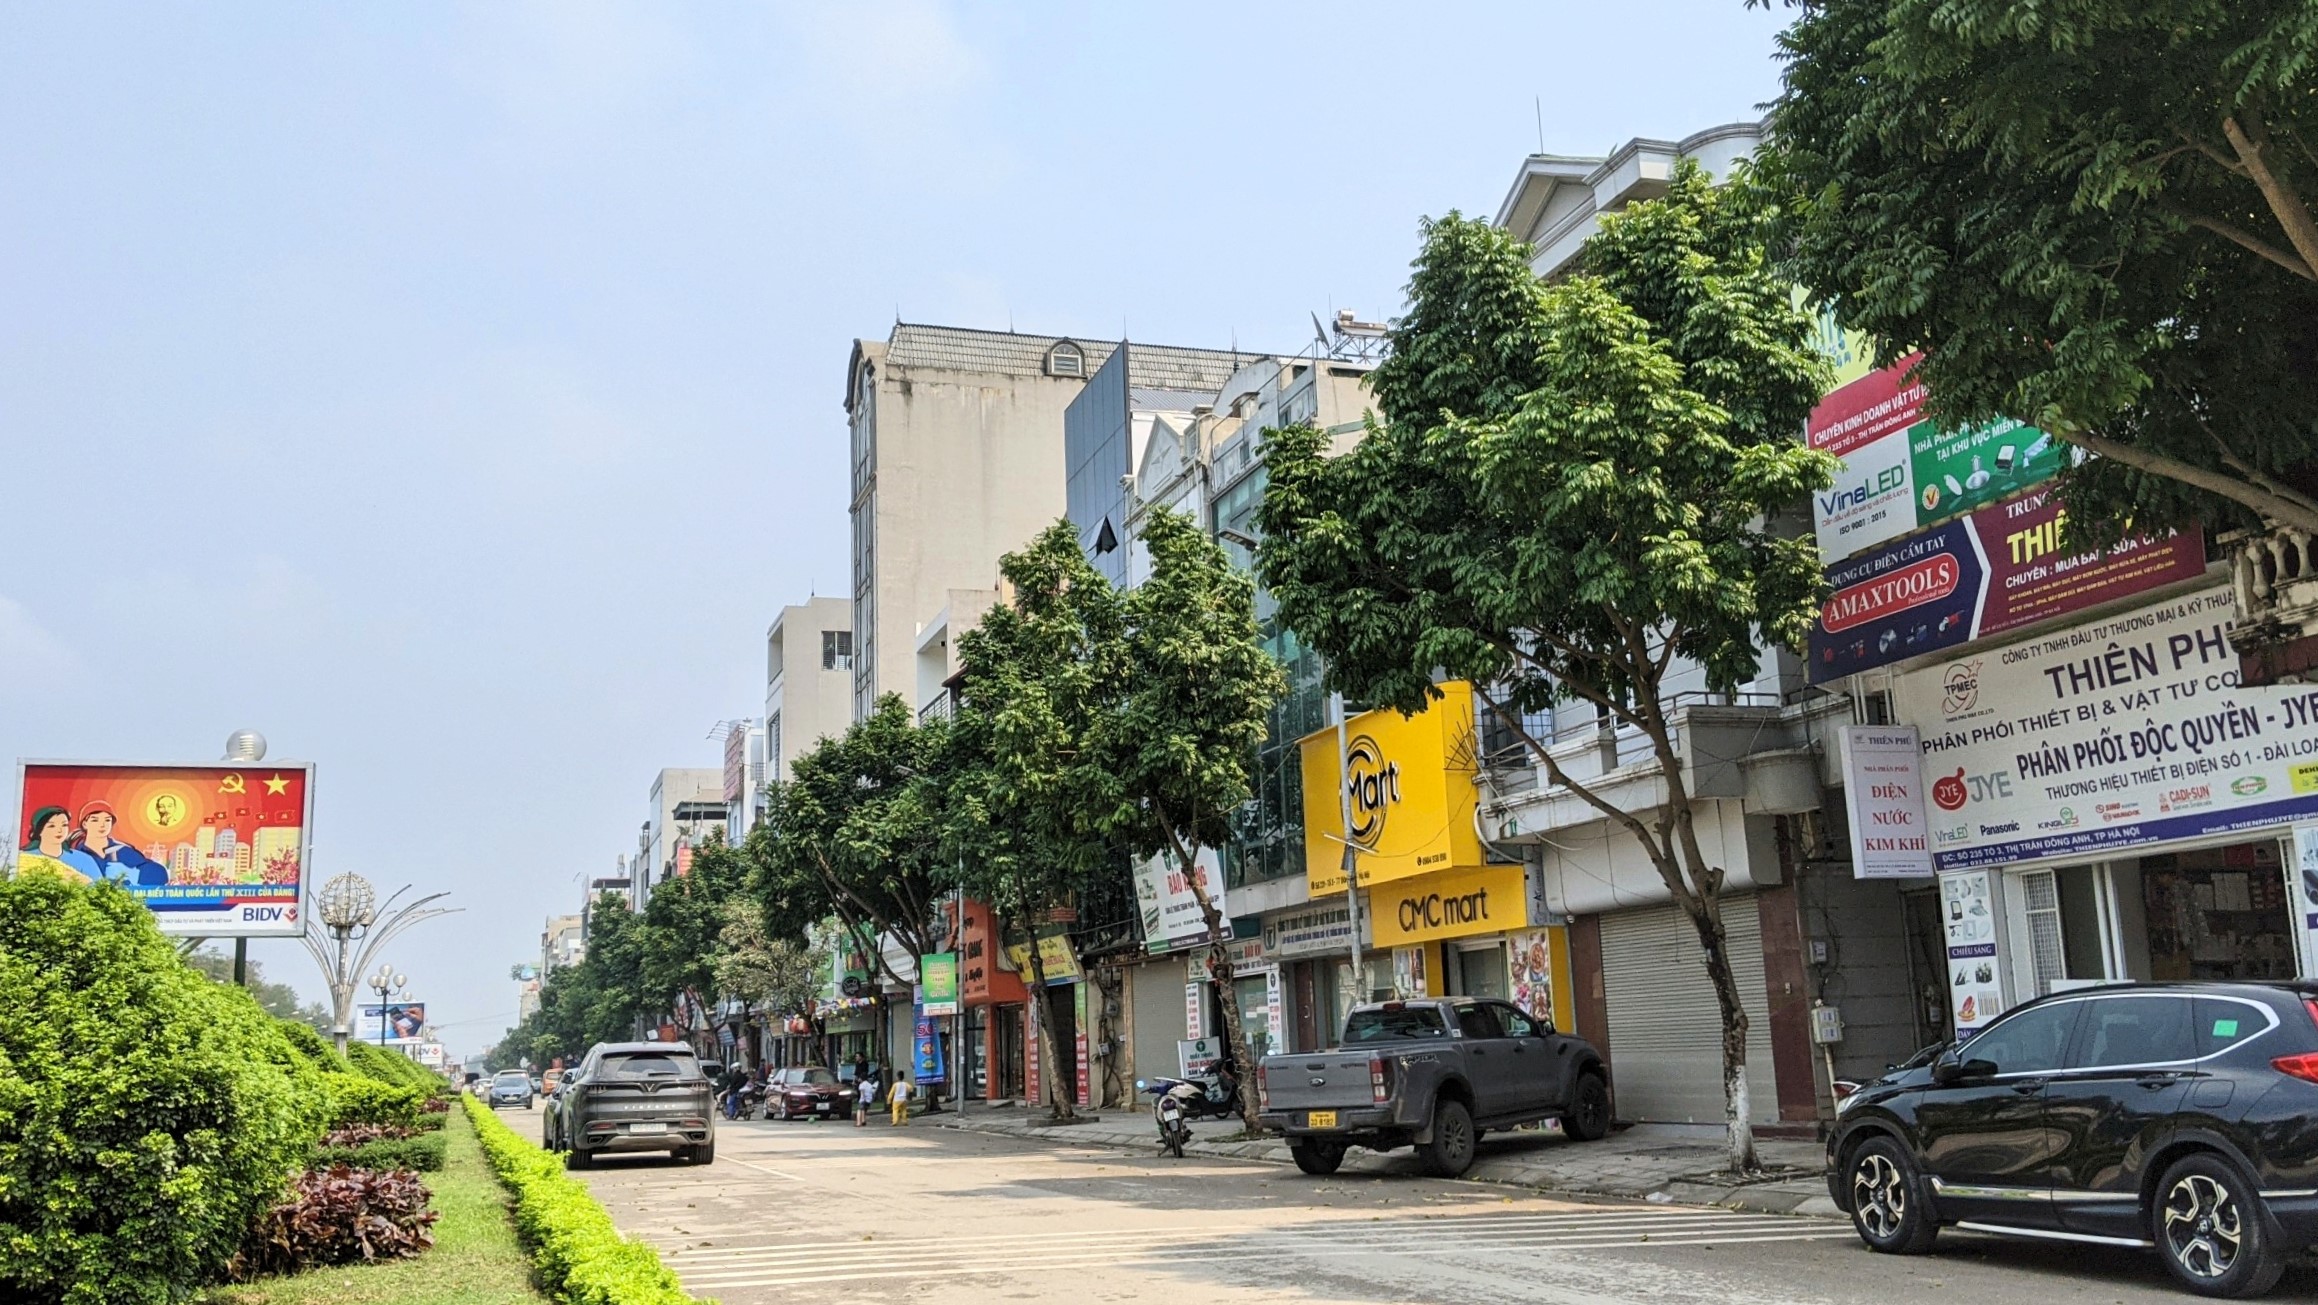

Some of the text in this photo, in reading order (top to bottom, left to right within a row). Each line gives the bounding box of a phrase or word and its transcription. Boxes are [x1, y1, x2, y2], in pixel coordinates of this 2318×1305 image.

[1814, 420, 1844, 446] CHUYÊN
[1844, 413, 1863, 433] KINH
[1863, 401, 1892, 426] DOANH
[1890, 392, 1909, 412] VẬT
[1903, 407, 1916, 422] ANH
[1915, 435, 1932, 455] NHÀ
[1936, 449, 1950, 462] TẠI
[1952, 441, 1969, 456] KHU
[1972, 428, 1990, 447] VỰC
[1820, 464, 1904, 516] VinaLED
[1839, 510, 1887, 535] ISO 9001 2015
[2007, 508, 2070, 566] THIÊ
[1859, 562, 1873, 577] CỤ
[1875, 552, 1898, 571] ĐIỆN
[1925, 534, 1946, 554] TAY
[2006, 565, 2047, 589] CHUYÊN
[2055, 556, 2079, 574] MUA
[2113, 536, 2138, 556] SỬA
[1828, 562, 1950, 623] AMAXTOOLS
[2002, 647, 2029, 665] CÔNG
[2029, 643, 2042, 658] TY
[2043, 639, 2070, 656] TNHH
[2071, 629, 2092, 647] ĐẦU
[2093, 627, 2108, 642] TƯ
[2109, 614, 2155, 638] THƯƠNG
[2157, 607, 2176, 626] MẠI
[2178, 605, 2187, 618] &
[2188, 597, 2203, 616] KỸ
[2044, 621, 2235, 699] THIÊN PH
[1944, 679, 1978, 696] TPMEC
[1922, 731, 1968, 754] PHÂN
[2077, 703, 2097, 722] BỊ
[2102, 699, 2116, 715] &
[2120, 687, 2161, 712] VẬT
[2167, 681, 2199, 701] TƯ
[1868, 735, 1894, 745] THIÊN
[2016, 741, 2070, 780] PHÂN
[2073, 726, 2128, 769] PHỐI
[2130, 718, 2177, 762] ĐỘC
[2181, 700, 2261, 755] QUYỀN
[2045, 780, 2097, 801] THƯƠNG
[2101, 772, 2129, 794] HIỆU
[2170, 763, 2185, 780] BỊ
[2186, 757, 2218, 778] ĐIỆN
[2221, 749, 2241, 769] SỐ
[2244, 750, 2252, 764] 1
[2263, 740, 2290, 761] ĐÀI
[2291, 737, 2318, 757] LOA
[1871, 782, 1908, 801] ĐIỆN
[1939, 783, 1959, 799] JYE
[1967, 771, 2014, 803] JYE
[1872, 808, 1913, 826] NƯỚC
[1980, 820, 2020, 836] Panasonic
[2202, 824, 2229, 835] Email:
[1865, 834, 1926, 851] KIM KHÍ
[1969, 850, 1983, 859] 235
[2005, 844, 2020, 854] THỊ
[2044, 836, 2071, 848] ĐÔNG
[2095, 832, 2106, 841] TP
[2107, 828, 2121, 839] HÀ
[2123, 826, 2141, 839] NỘI
[185, 886, 204, 898] QUỐC
[206, 886, 219, 898] LẦN
[242, 907, 283, 922] BIDV
[1399, 887, 1489, 932] CMC mart
